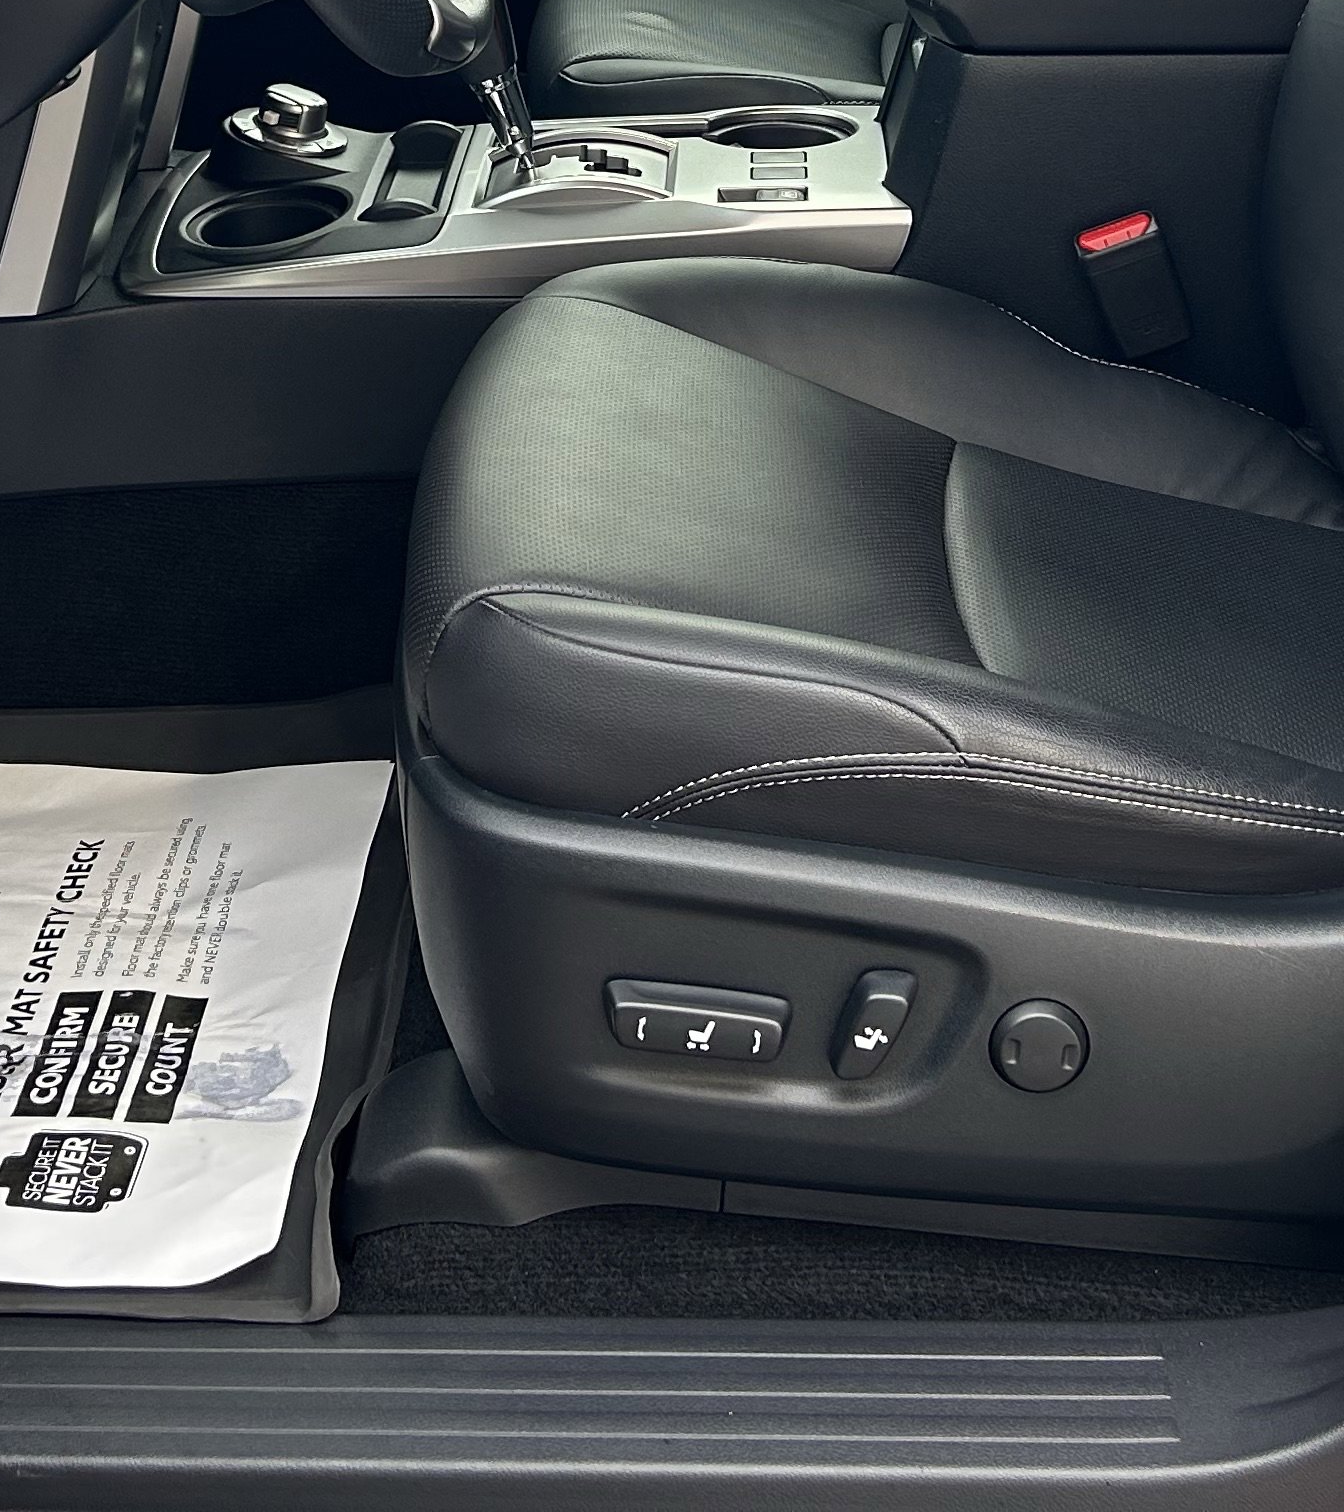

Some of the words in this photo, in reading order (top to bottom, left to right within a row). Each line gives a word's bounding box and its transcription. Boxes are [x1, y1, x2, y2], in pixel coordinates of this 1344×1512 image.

[2, 989, 43, 1035] MAT
[23, 907, 74, 983] SAFETY
[56, 839, 105, 903] CHECK
[176, 957, 194, 982] Make
[201, 965, 213, 984] and
[30, 1007, 90, 1104] CONFIRM
[88, 1014, 139, 1096] SECURE
[145, 1022, 194, 1096] COUNT
[22, 1150, 58, 1201] SECURE
[43, 1136, 62, 1148] IT
[42, 1138, 92, 1205] NEVER
[73, 1157, 110, 1206] STACK
[93, 1139, 114, 1155] IT
